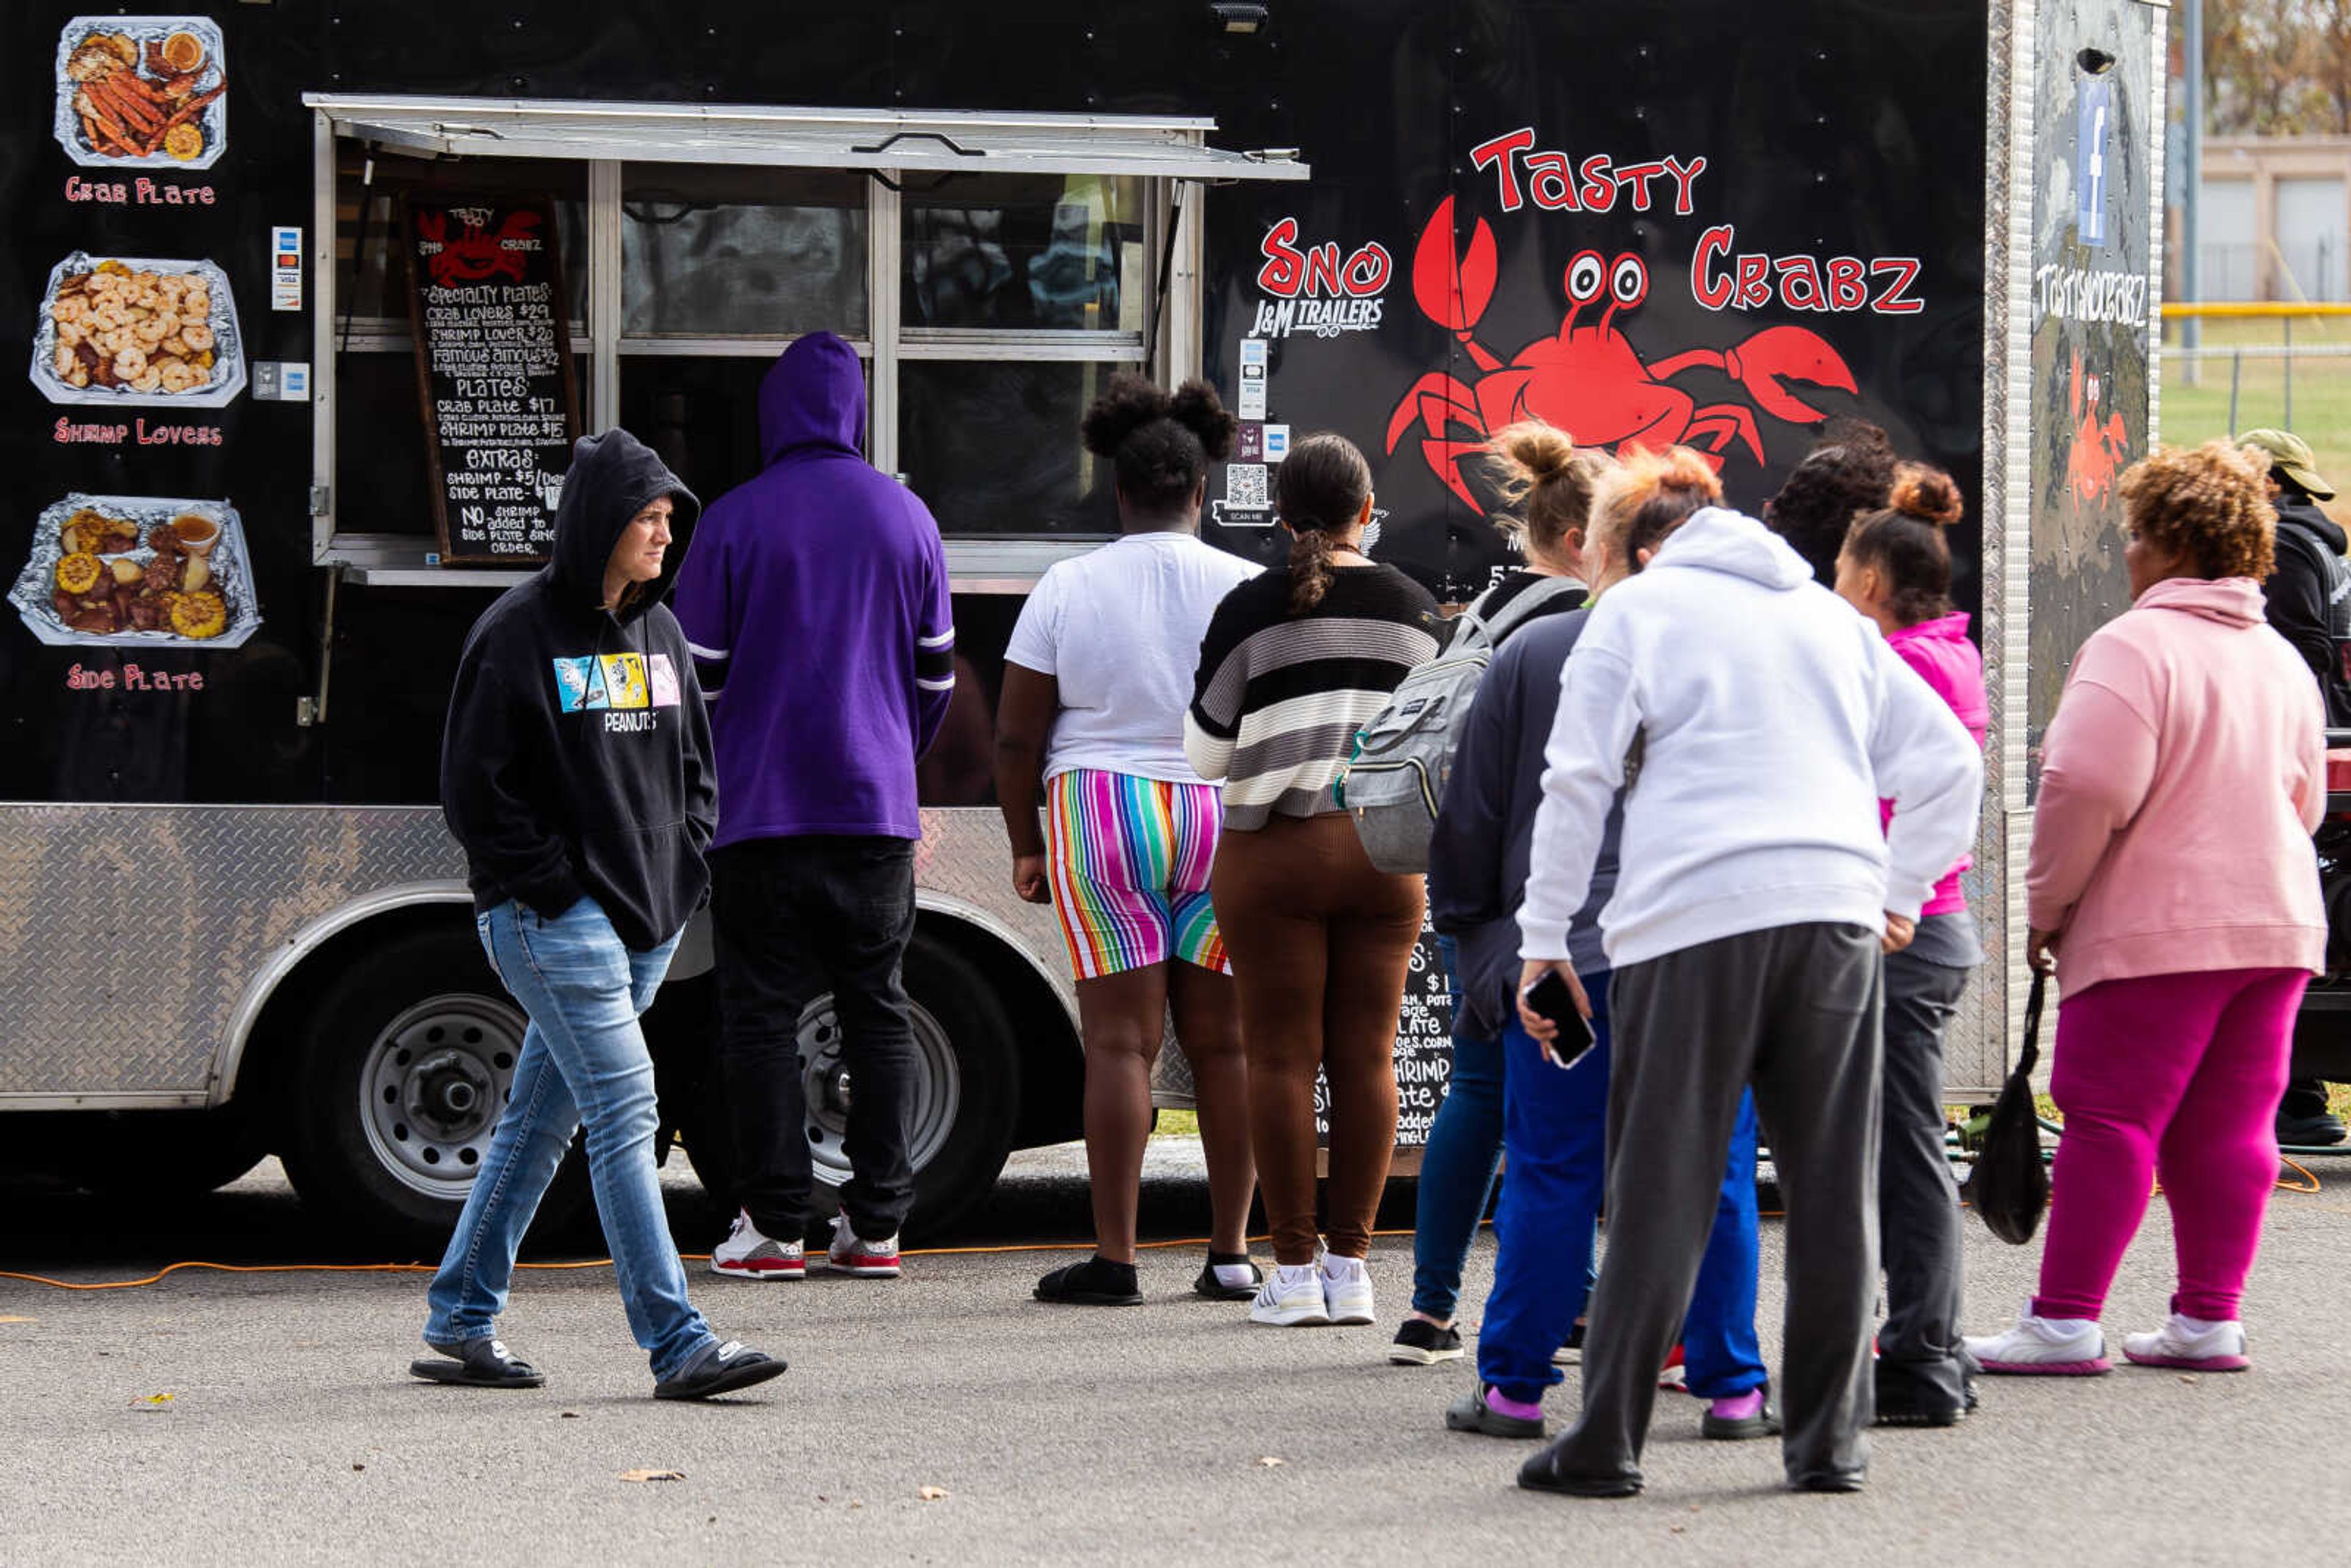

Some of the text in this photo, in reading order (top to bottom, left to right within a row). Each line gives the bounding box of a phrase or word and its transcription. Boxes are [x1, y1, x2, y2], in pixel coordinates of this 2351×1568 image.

[1470, 127, 1706, 214] Tasty
[65, 176, 216, 204] Crab Plate
[1258, 217, 1392, 298] Sno
[1691, 224, 1925, 313] Crabz
[520, 304, 549, 319] $29
[1248, 299, 1384, 339] J&M TRAILERS
[432, 328, 481, 340] SHRIMP
[528, 326, 554, 341] $20
[529, 397, 555, 413] $17
[54, 417, 223, 446] Shrimp Lovers
[440, 421, 497, 437] SHRIMP
[541, 421, 564, 438] $15
[447, 472, 501, 485] SHRIMP
[462, 506, 540, 527] NO SHRIMP
[487, 517, 546, 531] added to
[67, 663, 205, 691] Side Plate
[1397, 1016, 1441, 1035] LATe
[1393, 1058, 1450, 1082] HRIMP
